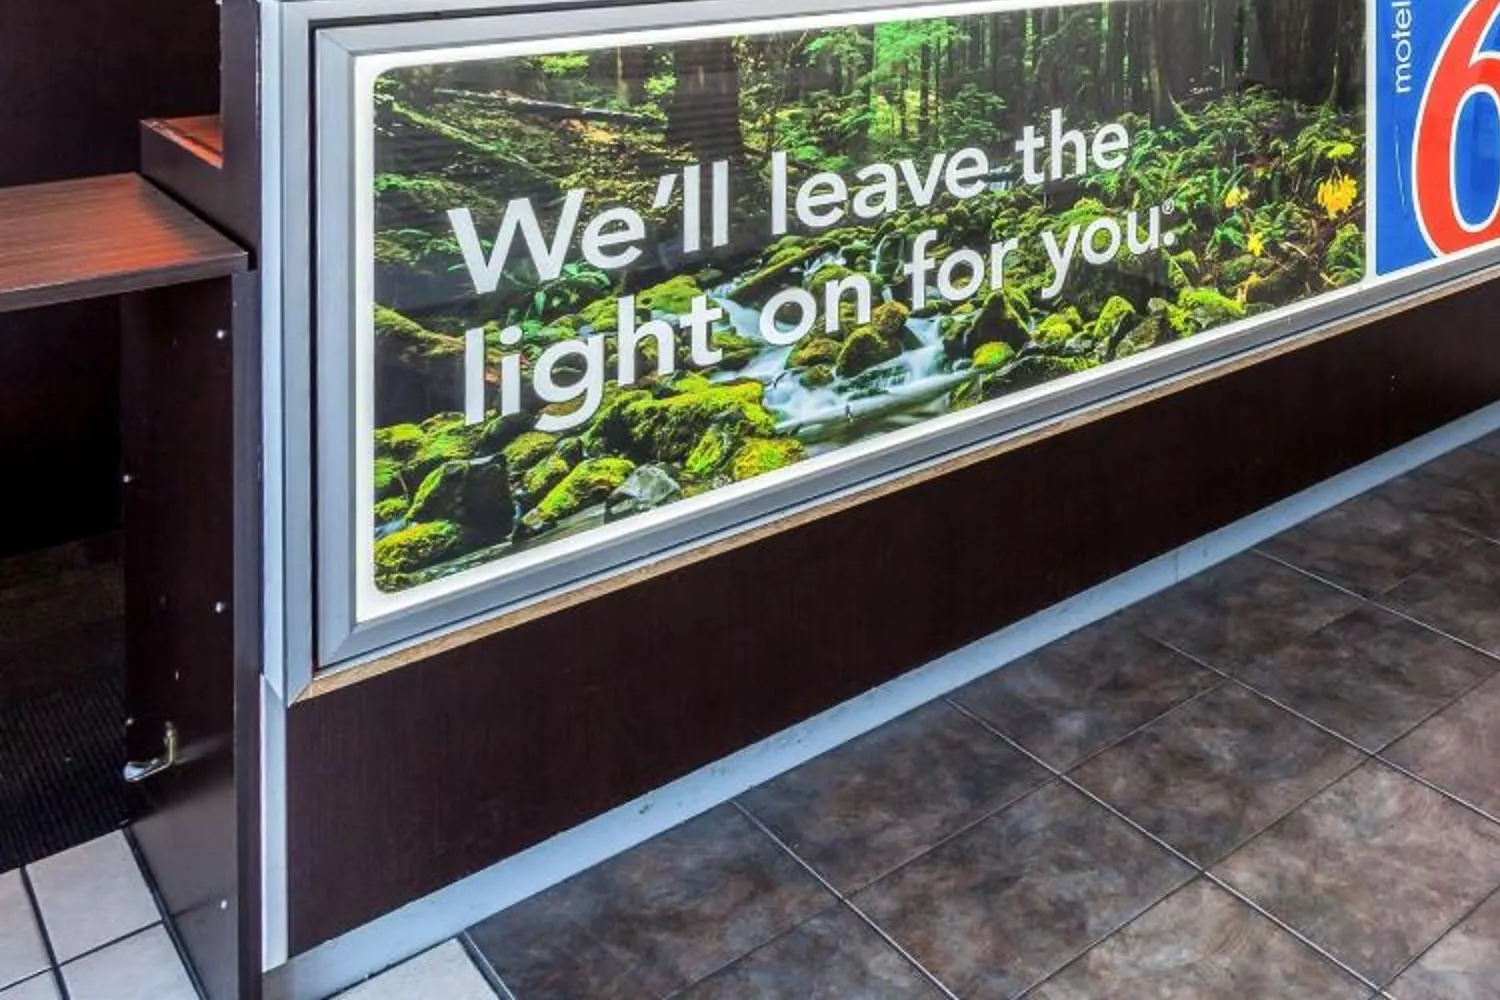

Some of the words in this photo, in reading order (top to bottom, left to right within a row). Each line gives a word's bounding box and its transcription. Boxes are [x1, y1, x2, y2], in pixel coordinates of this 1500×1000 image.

[1391, 0, 1412, 93] motel
[447, 158, 730, 296] We'll
[771, 145, 990, 236] leave
[1014, 107, 1130, 188] the
[464, 292, 723, 433] light
[758, 271, 872, 347] on
[903, 229, 1019, 312] for
